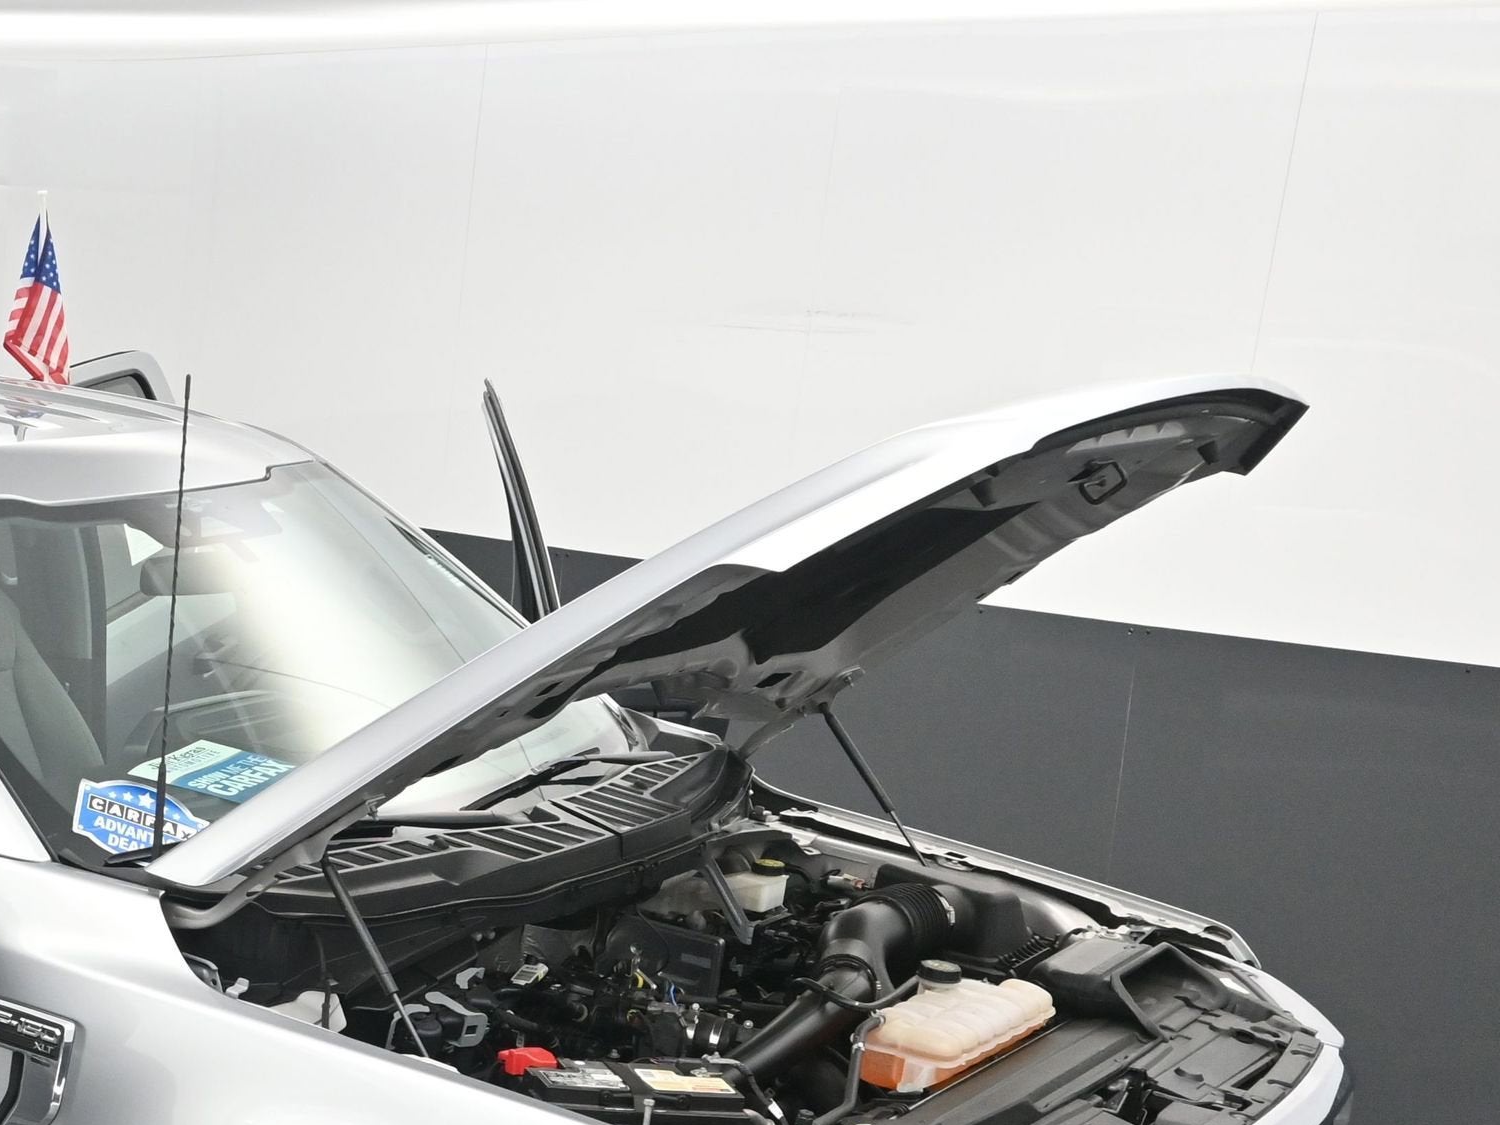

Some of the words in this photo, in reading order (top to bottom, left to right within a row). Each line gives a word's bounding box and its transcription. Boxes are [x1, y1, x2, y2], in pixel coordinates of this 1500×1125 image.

[187, 769, 226, 789] SHOW
[223, 760, 245, 776] ME
[240, 753, 267, 769] THE
[207, 760, 296, 796] CARFAX
[94, 815, 176, 844] ADVANT
[34, 1041, 55, 1054] XLT
